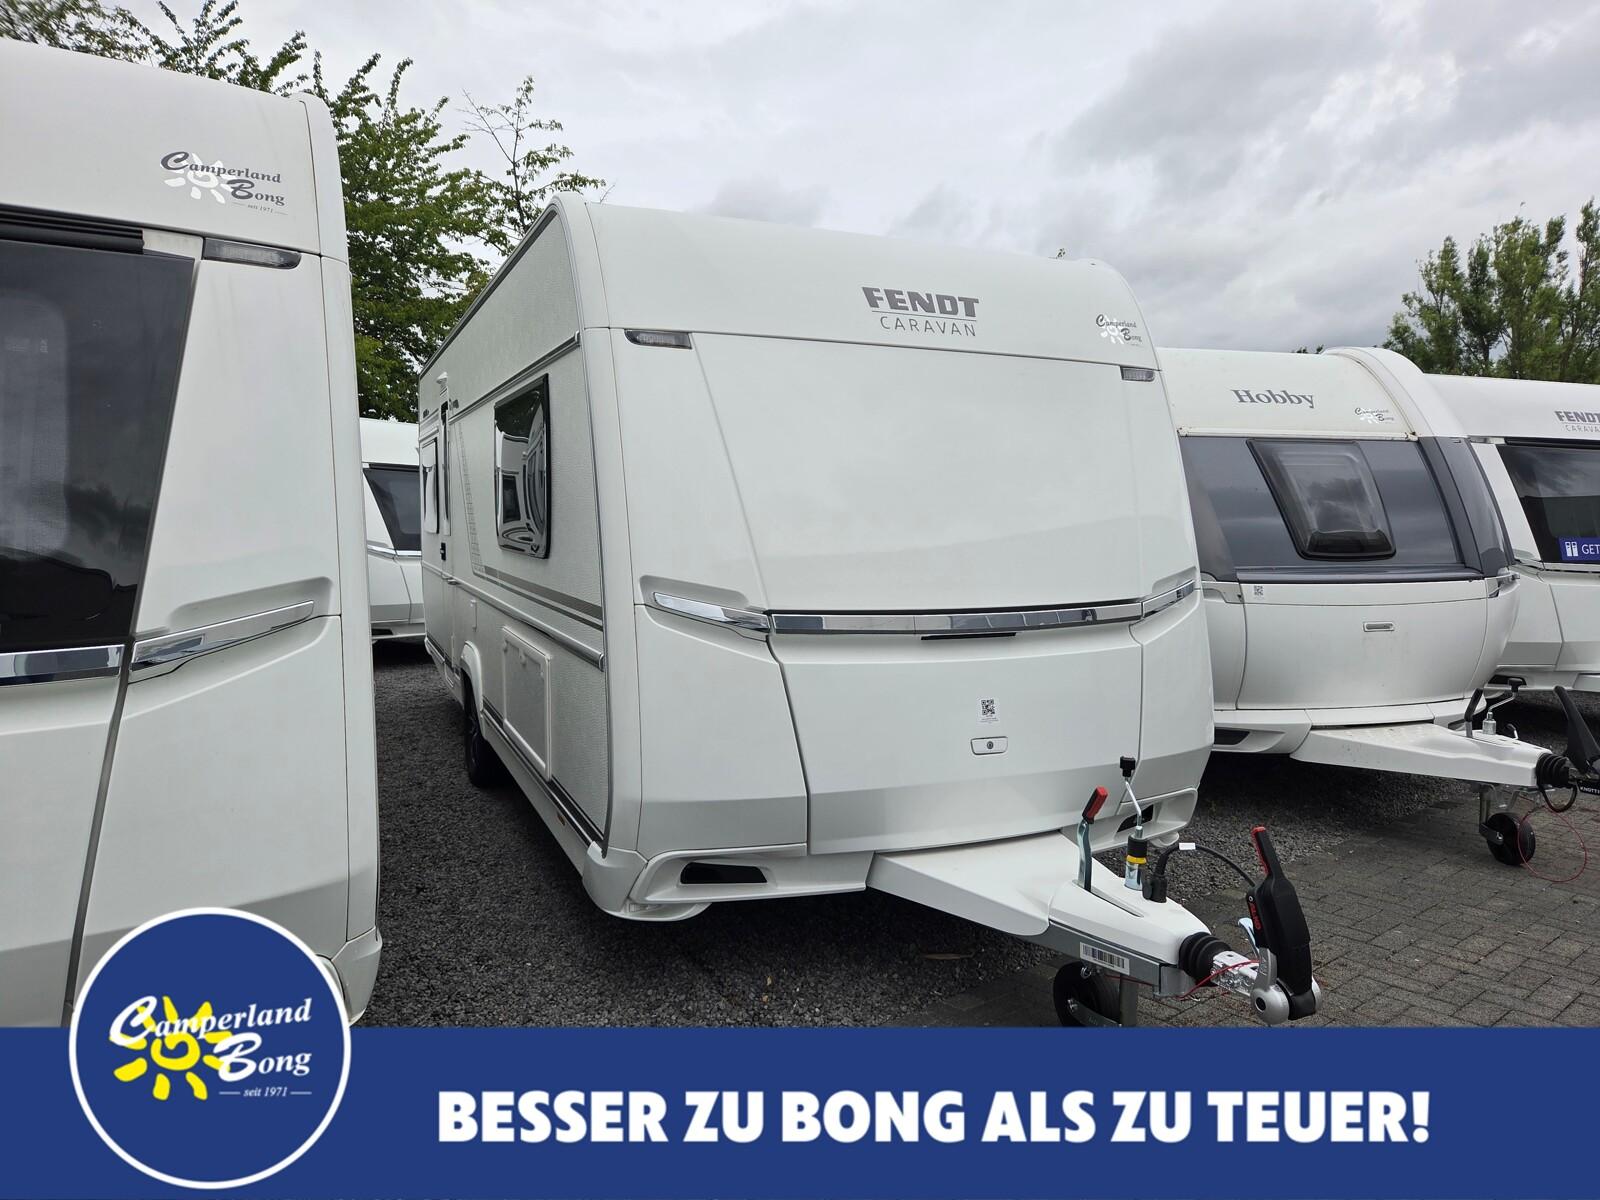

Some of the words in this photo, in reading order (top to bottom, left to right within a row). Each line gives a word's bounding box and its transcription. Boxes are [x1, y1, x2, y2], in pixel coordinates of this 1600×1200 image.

[160, 151, 281, 183] Camperland
[226, 178, 285, 206] Bong
[862, 286, 980, 318] FENDT
[880, 315, 976, 337] CARAVAN
[1231, 389, 1315, 409] Hobby
[1565, 424, 1600, 433] CARAVA
